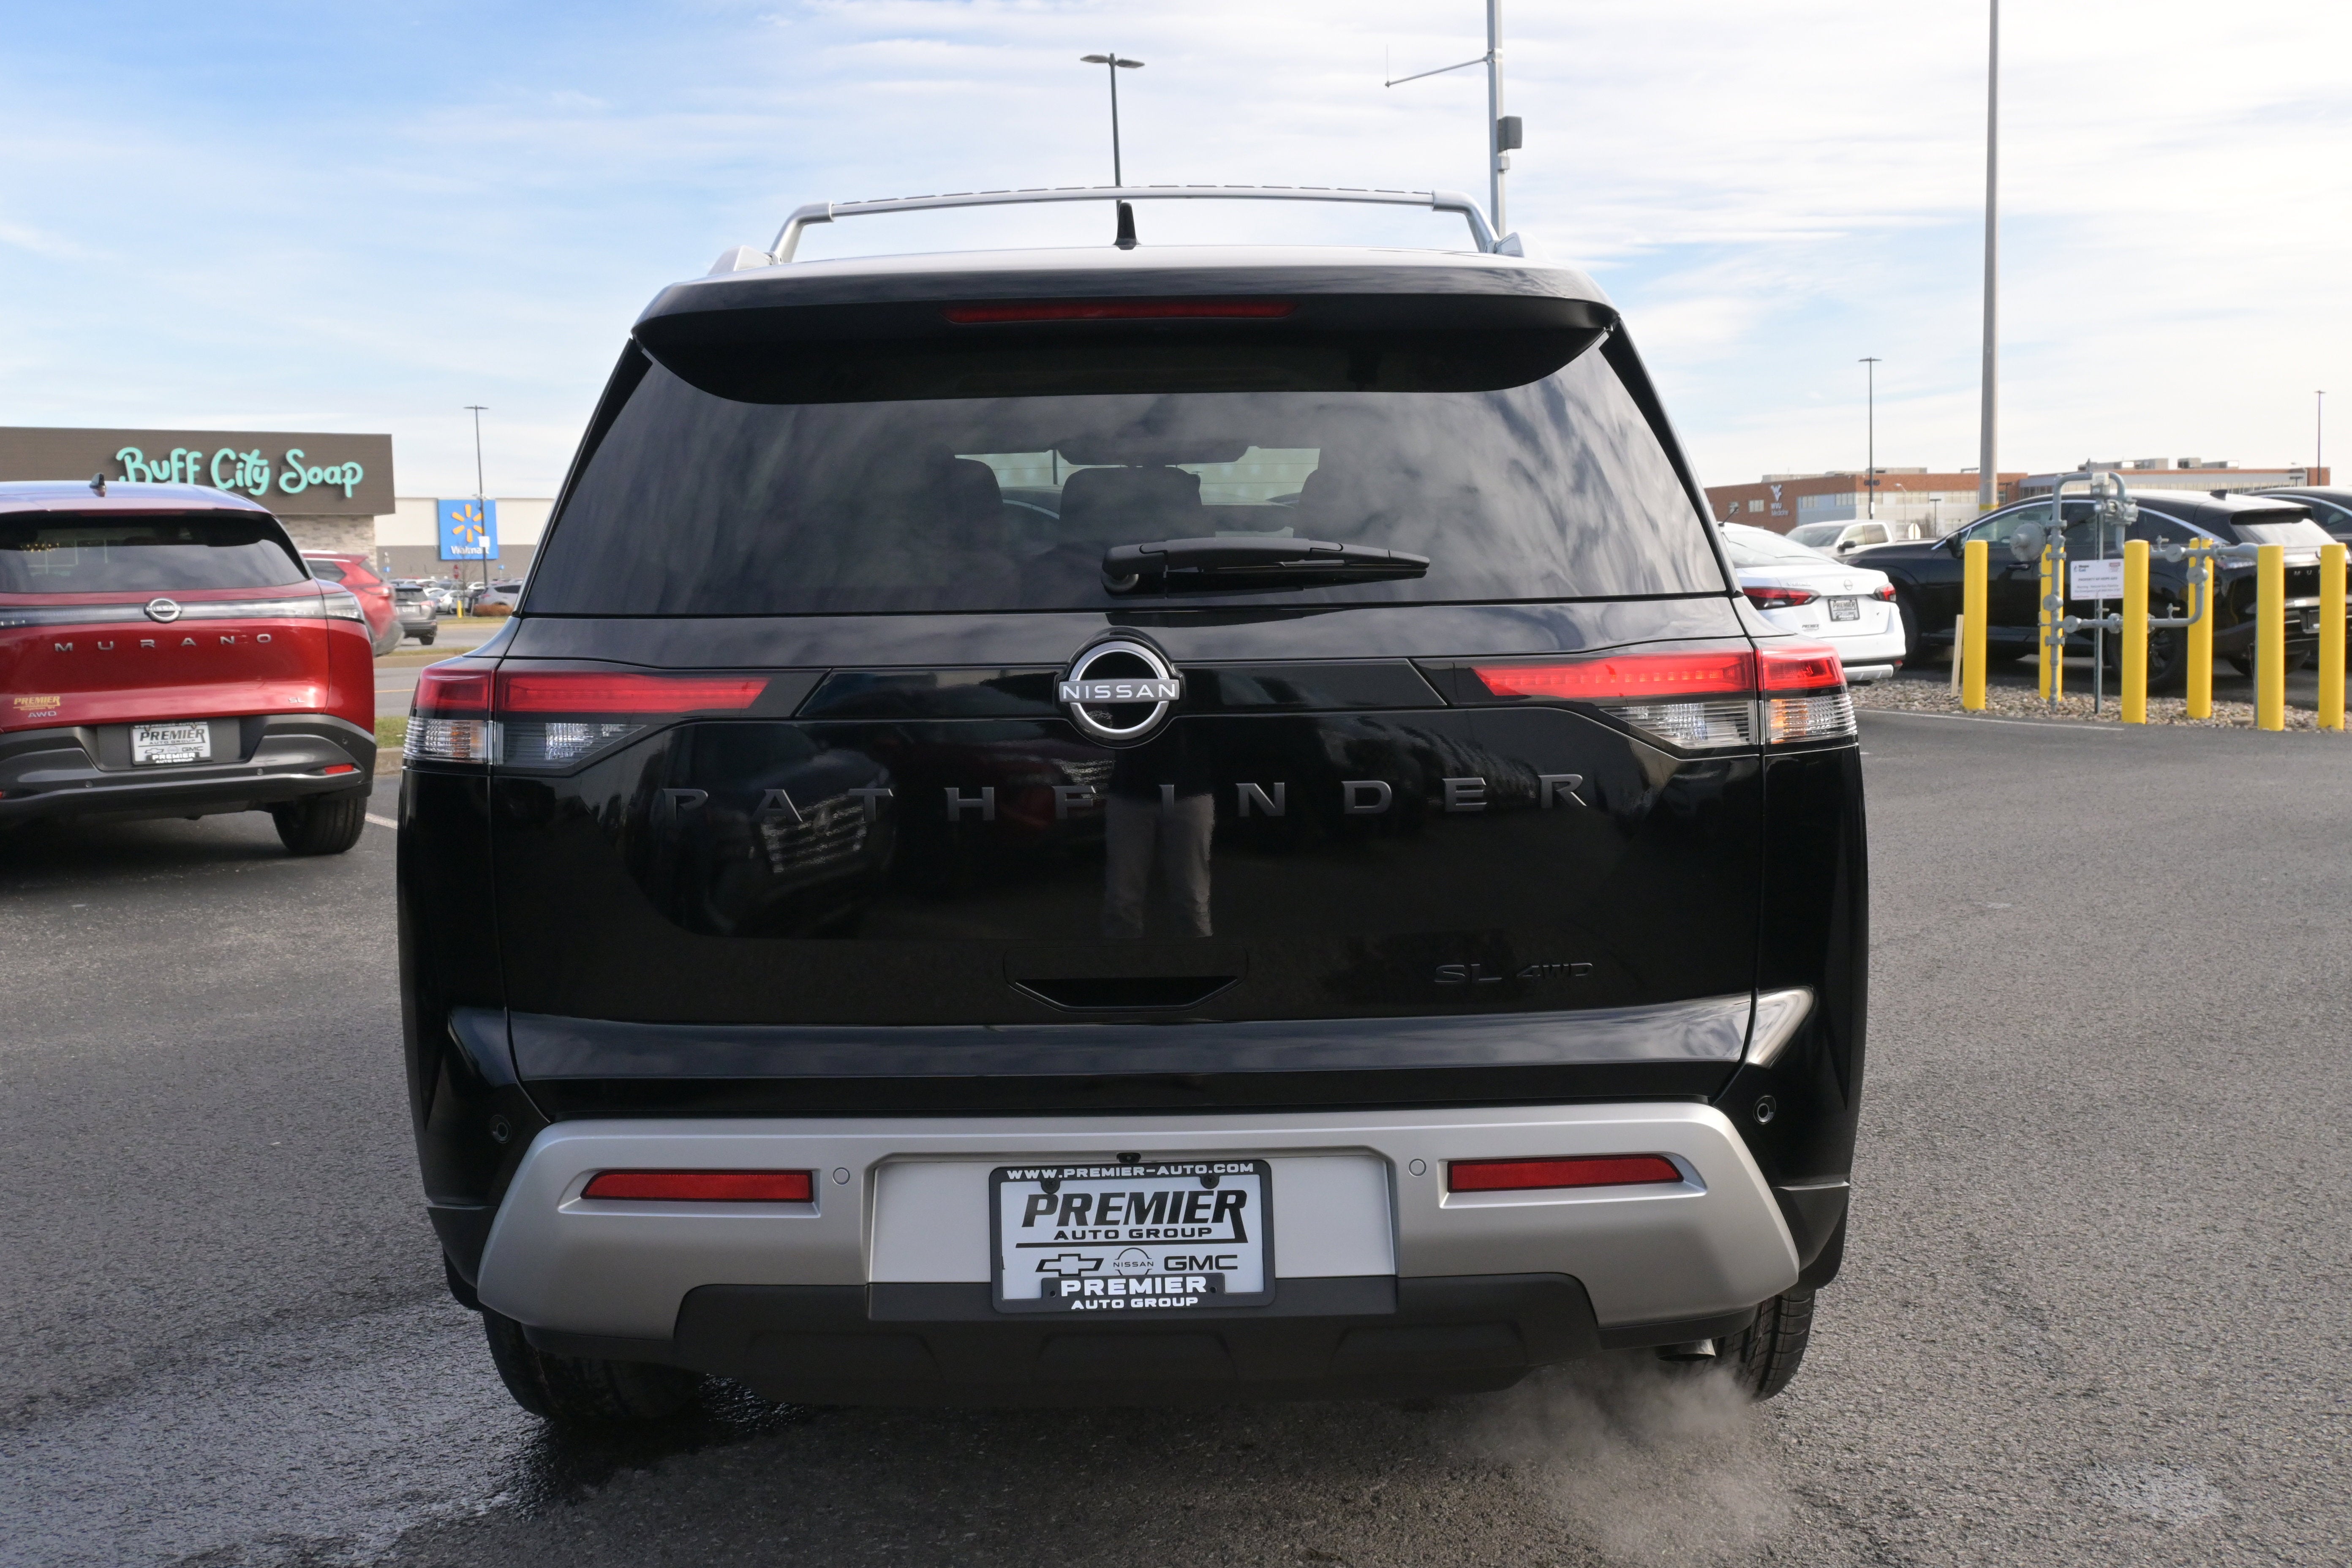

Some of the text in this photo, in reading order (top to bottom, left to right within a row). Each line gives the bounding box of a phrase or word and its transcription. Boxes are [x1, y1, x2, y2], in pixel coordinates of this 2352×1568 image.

[211, 448, 270, 495] City
[279, 449, 363, 498] Soap
[451, 546, 489, 554] Walmat
[1833, 602, 1855, 610] PREMIER
[55, 634, 272, 651] MURANO
[1063, 683, 1175, 699] NISSAN
[14, 696, 60, 706] PREMIER
[140, 729, 206, 743] PREMIER
[662, 773, 1587, 822] PATHFINDER
[1434, 963, 1502, 983] SL
[1007, 1162, 1254, 1179] WWW.PREMIER-AUTO.COM
[1021, 1190, 1248, 1243] PREMIER
[1054, 1227, 1212, 1240] AUTO GROUP
[1164, 1255, 1238, 1271] GMC
[1061, 1276, 1206, 1297] PREMIER
[1071, 1297, 1198, 1309] AUTO GROUP
